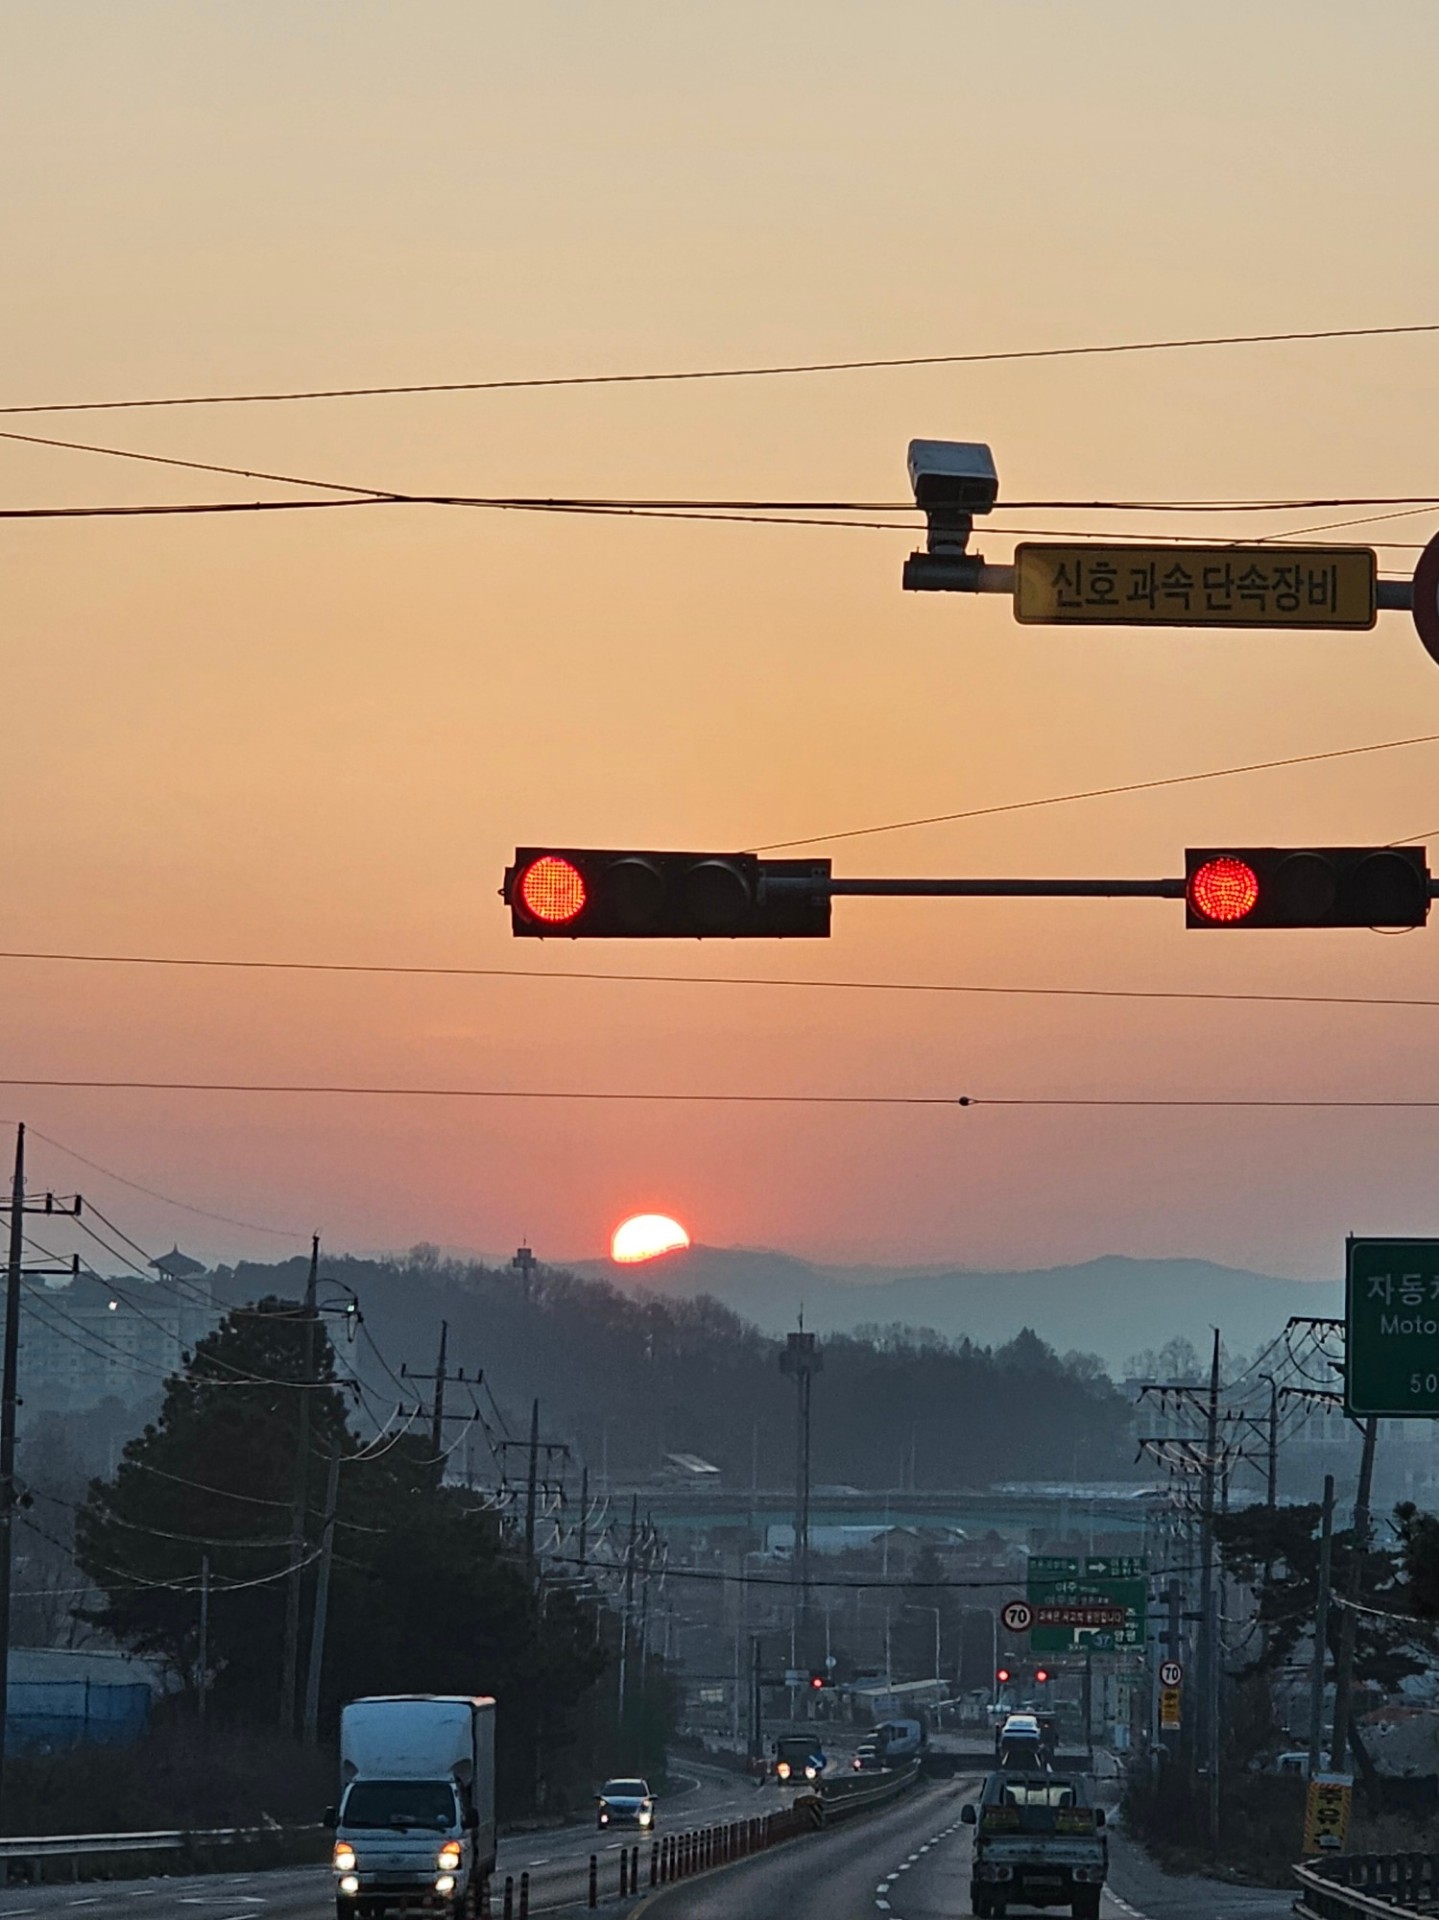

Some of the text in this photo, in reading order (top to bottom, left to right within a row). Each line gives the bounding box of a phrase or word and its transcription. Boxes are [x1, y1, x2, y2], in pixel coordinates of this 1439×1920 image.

[1050, 559, 1338, 614] 신호 과속 단속장비
[1380, 1313, 1439, 1335] Moto
[1008, 1609, 1027, 1624] 70
[1165, 1667, 1179, 1681] 70
